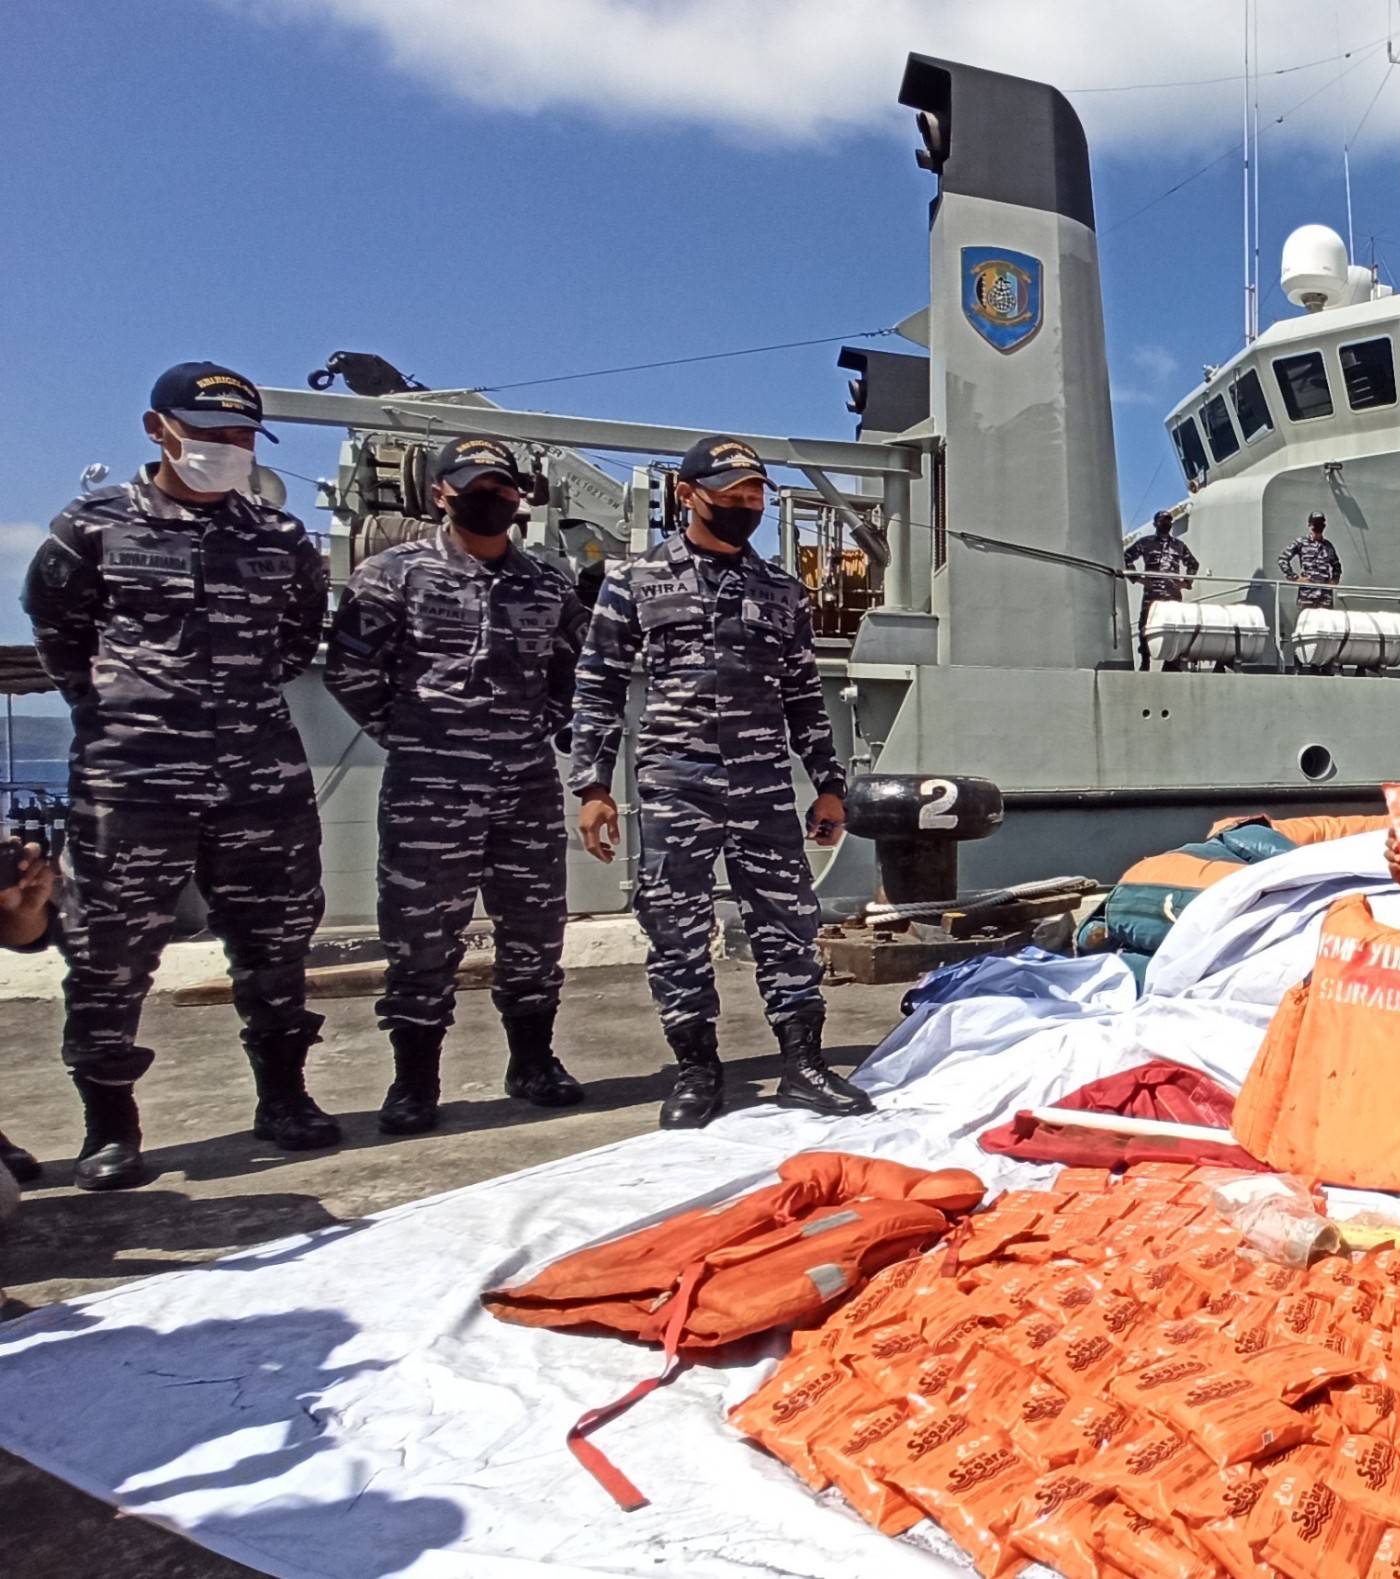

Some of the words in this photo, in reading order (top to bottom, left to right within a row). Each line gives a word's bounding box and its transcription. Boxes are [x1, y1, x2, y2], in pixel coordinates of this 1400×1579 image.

[642, 582, 688, 598] WIRA
[918, 778, 959, 830] 2
[1139, 1360, 1196, 1384] Segara
[772, 1371, 833, 1416] Segara
[907, 1413, 959, 1454] Segara
[948, 1447, 1010, 1485] Segara
[1356, 1440, 1388, 1482] Segara
[1291, 1482, 1325, 1527] Segara
